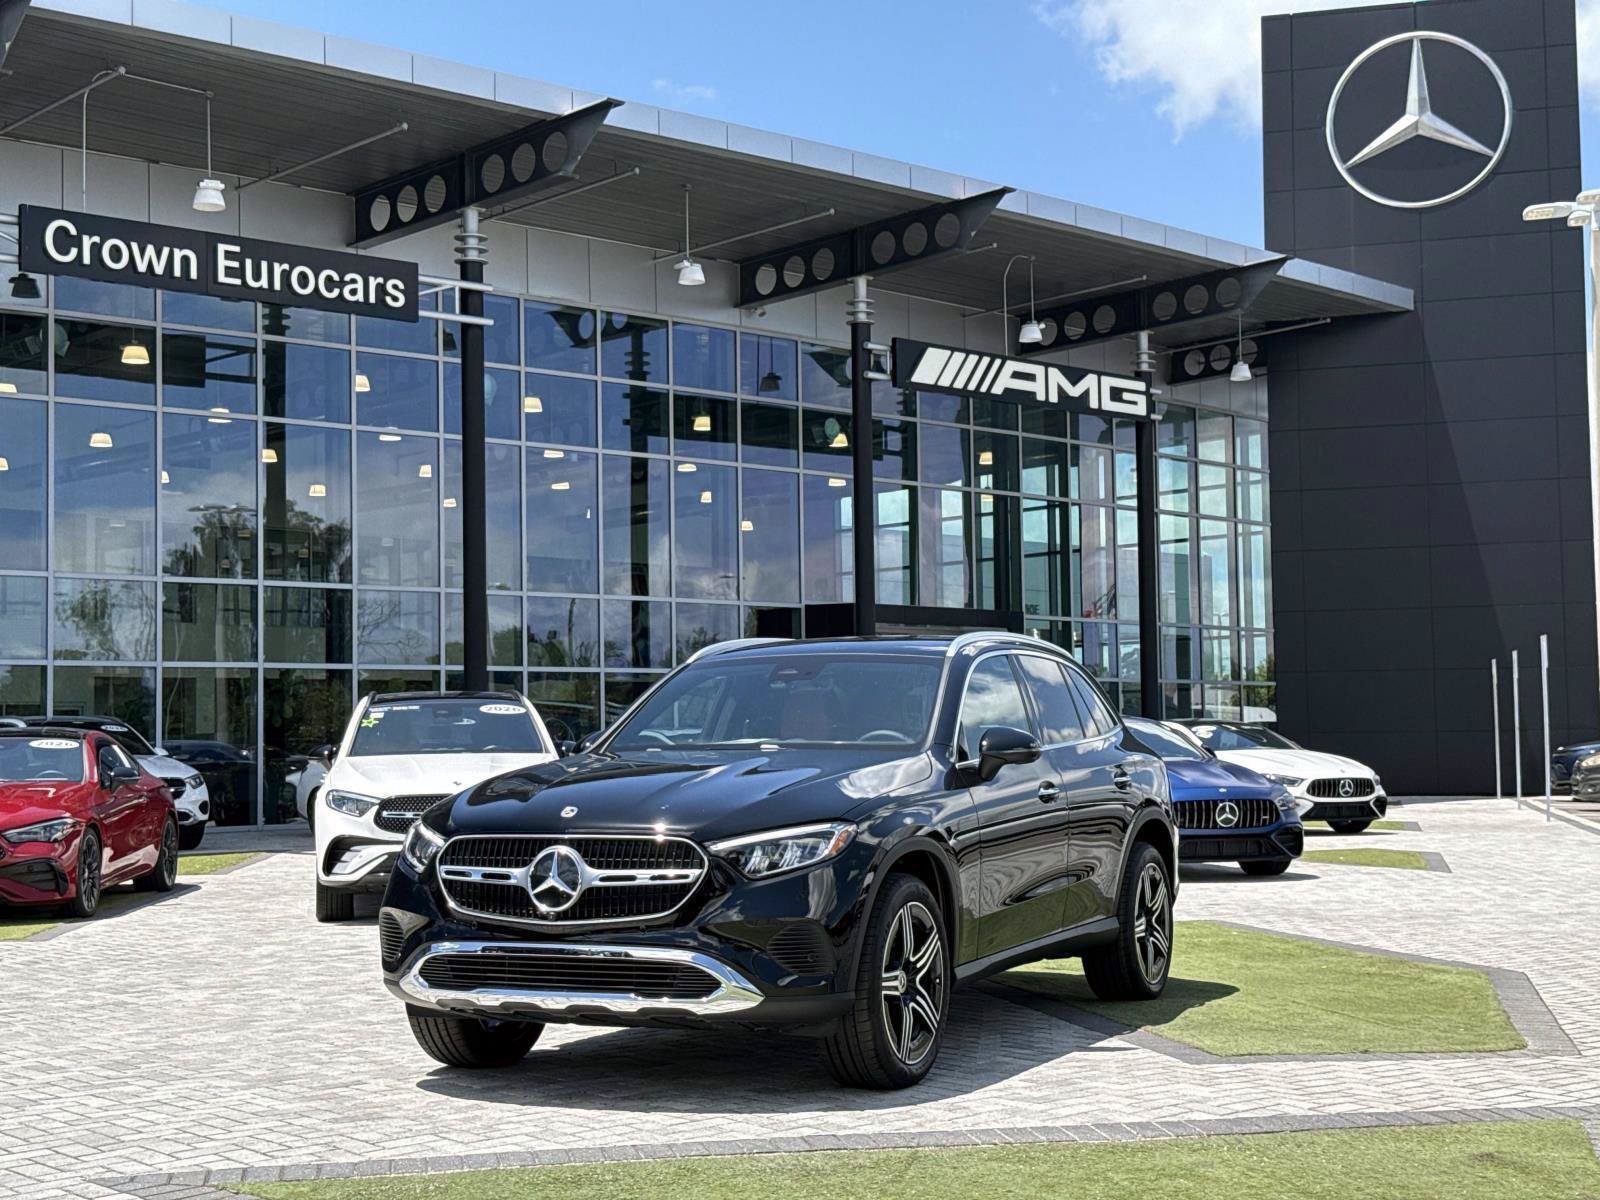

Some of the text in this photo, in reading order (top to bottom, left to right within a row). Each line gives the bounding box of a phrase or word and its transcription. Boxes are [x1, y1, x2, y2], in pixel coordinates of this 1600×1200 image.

[44, 219, 406, 308] Crown Eurocars
[991, 360, 1147, 416] AMG
